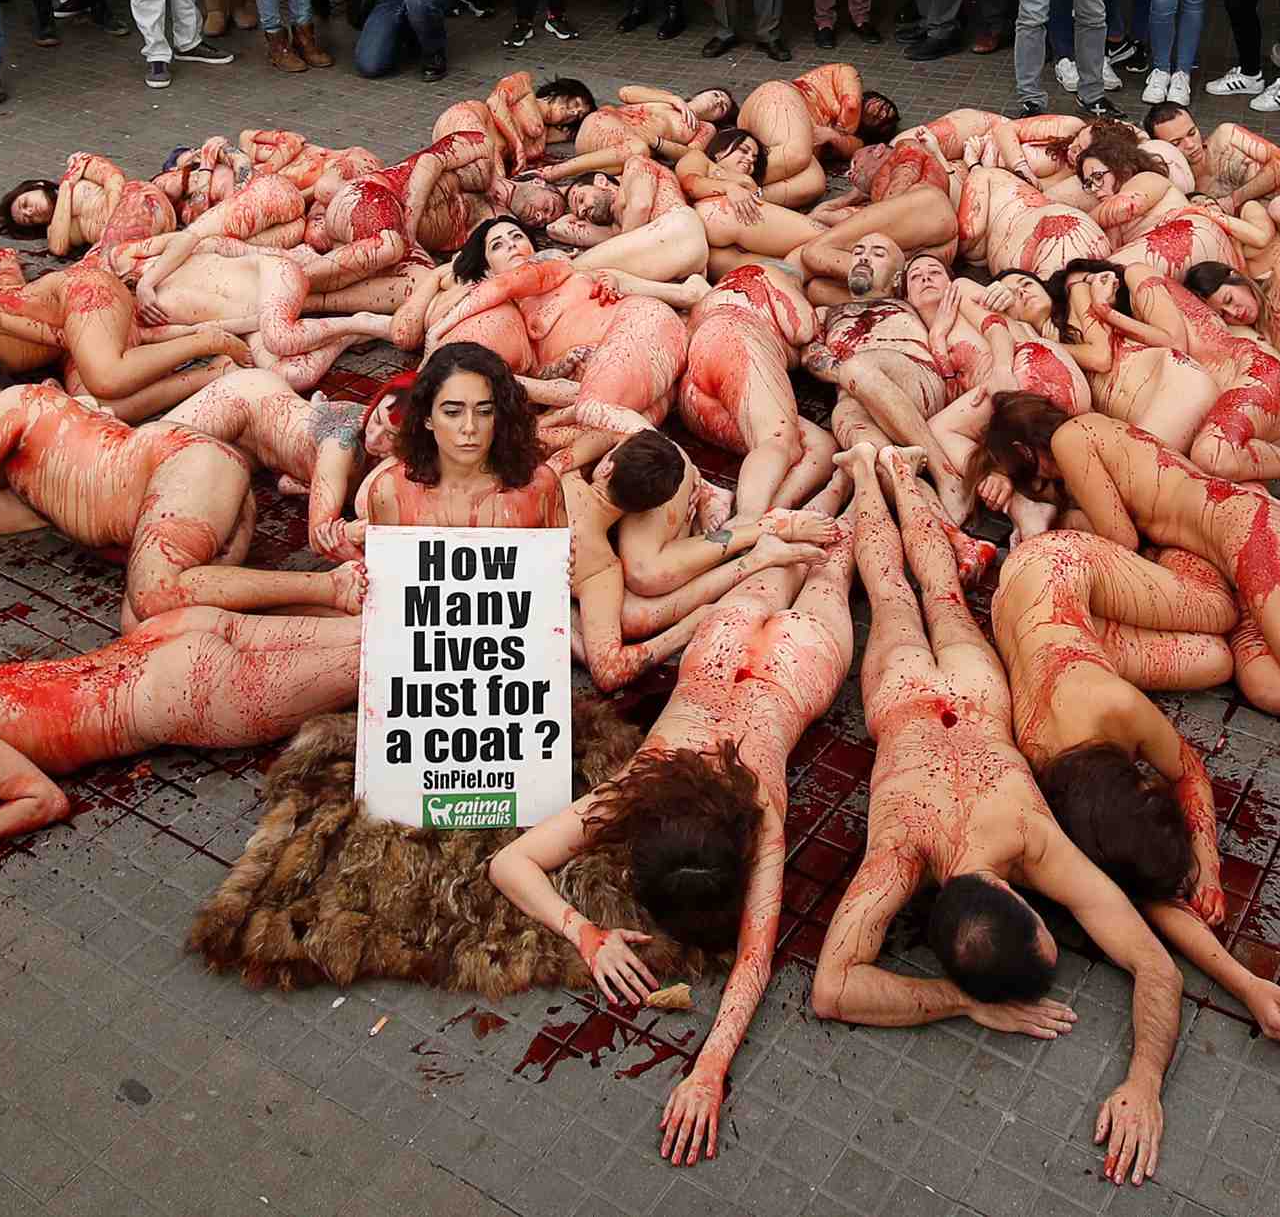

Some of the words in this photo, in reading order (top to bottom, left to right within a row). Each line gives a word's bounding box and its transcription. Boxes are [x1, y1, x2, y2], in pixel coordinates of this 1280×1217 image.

[419, 541, 518, 581] How
[404, 586, 532, 629] Many
[413, 631, 526, 672] Lives
[387, 677, 477, 718] Just
[487, 675, 550, 716] for
[386, 729, 412, 763] a
[424, 722, 523, 763] coat
[535, 720, 561, 760] ?
[423, 770, 515, 790] SinPiel.org
[453, 796, 511, 814] anima
[453, 812, 512, 827] naturalis
